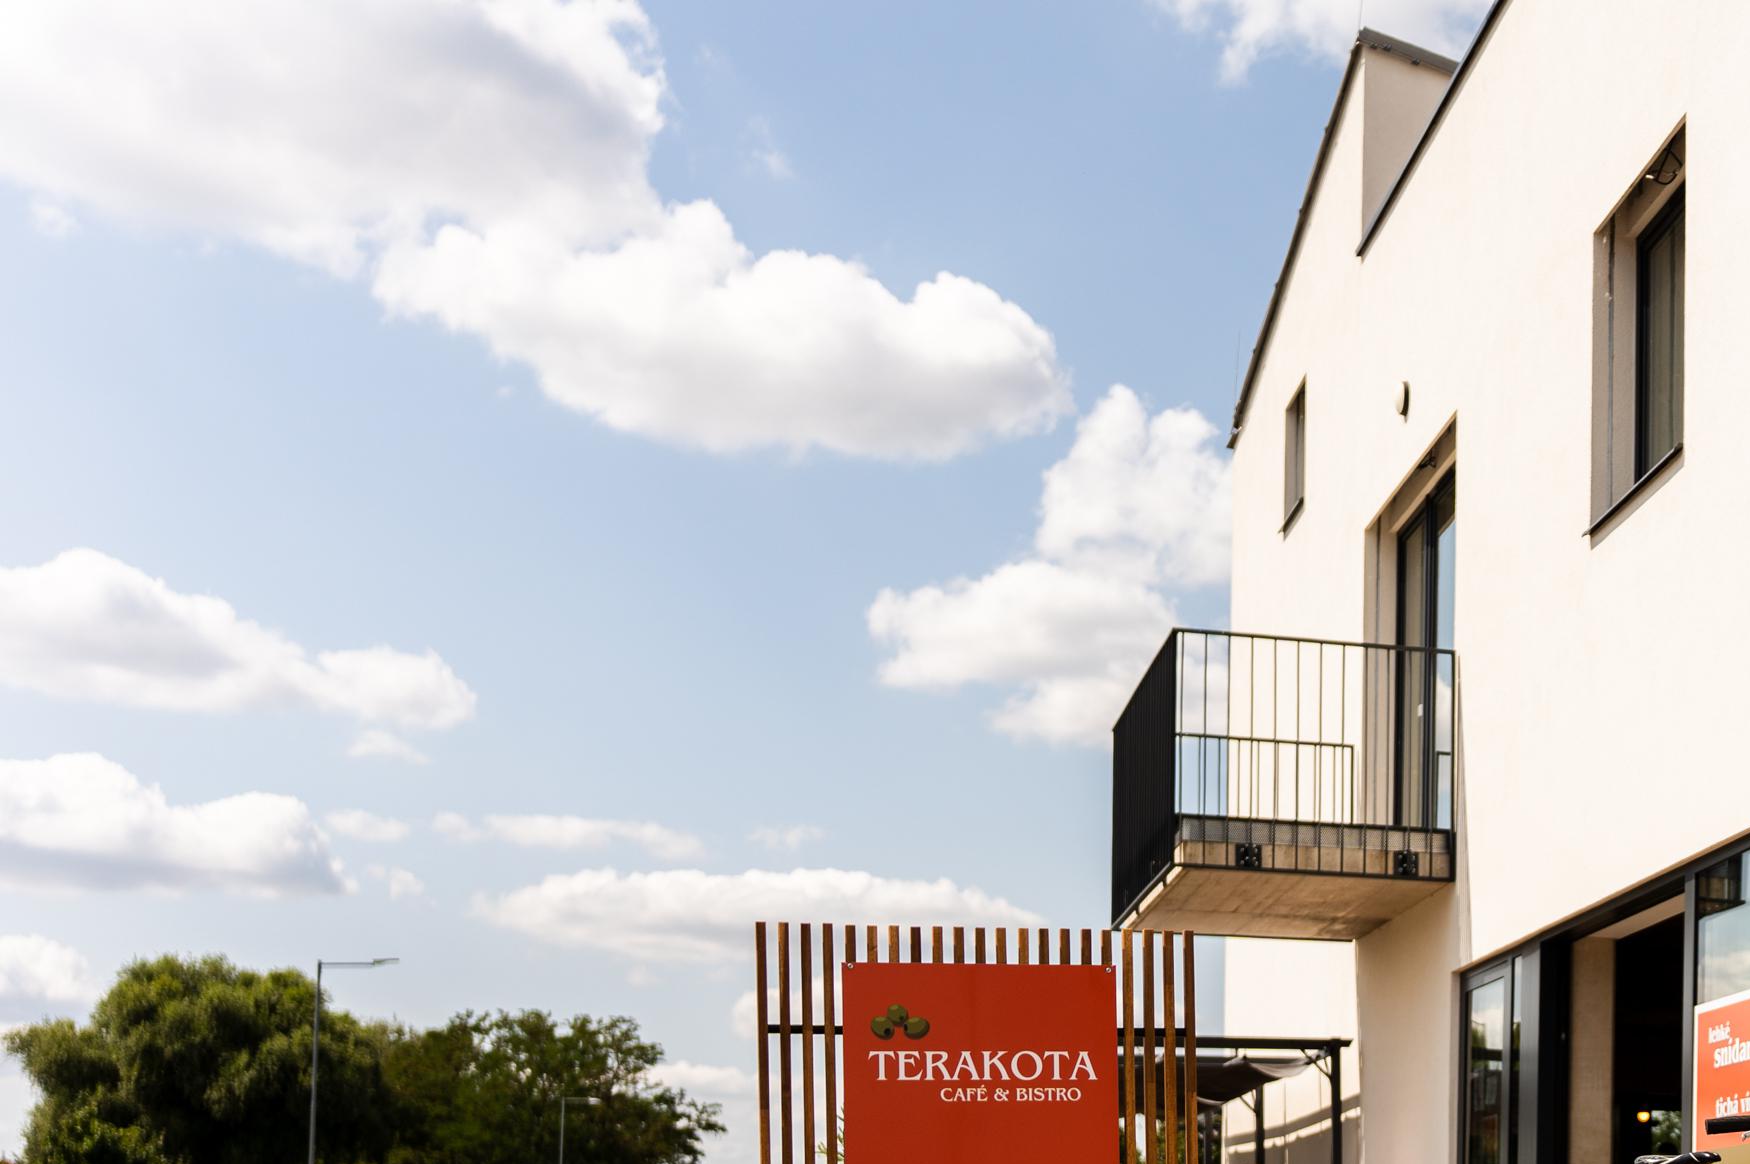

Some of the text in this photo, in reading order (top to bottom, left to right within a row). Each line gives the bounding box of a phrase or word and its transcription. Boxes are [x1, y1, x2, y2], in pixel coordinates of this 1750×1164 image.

[868, 1050, 1098, 1081] TERAKOTA
[940, 1084, 1082, 1102] CAFÉ & BISTRO
[1715, 1093, 1739, 1118] tichá
